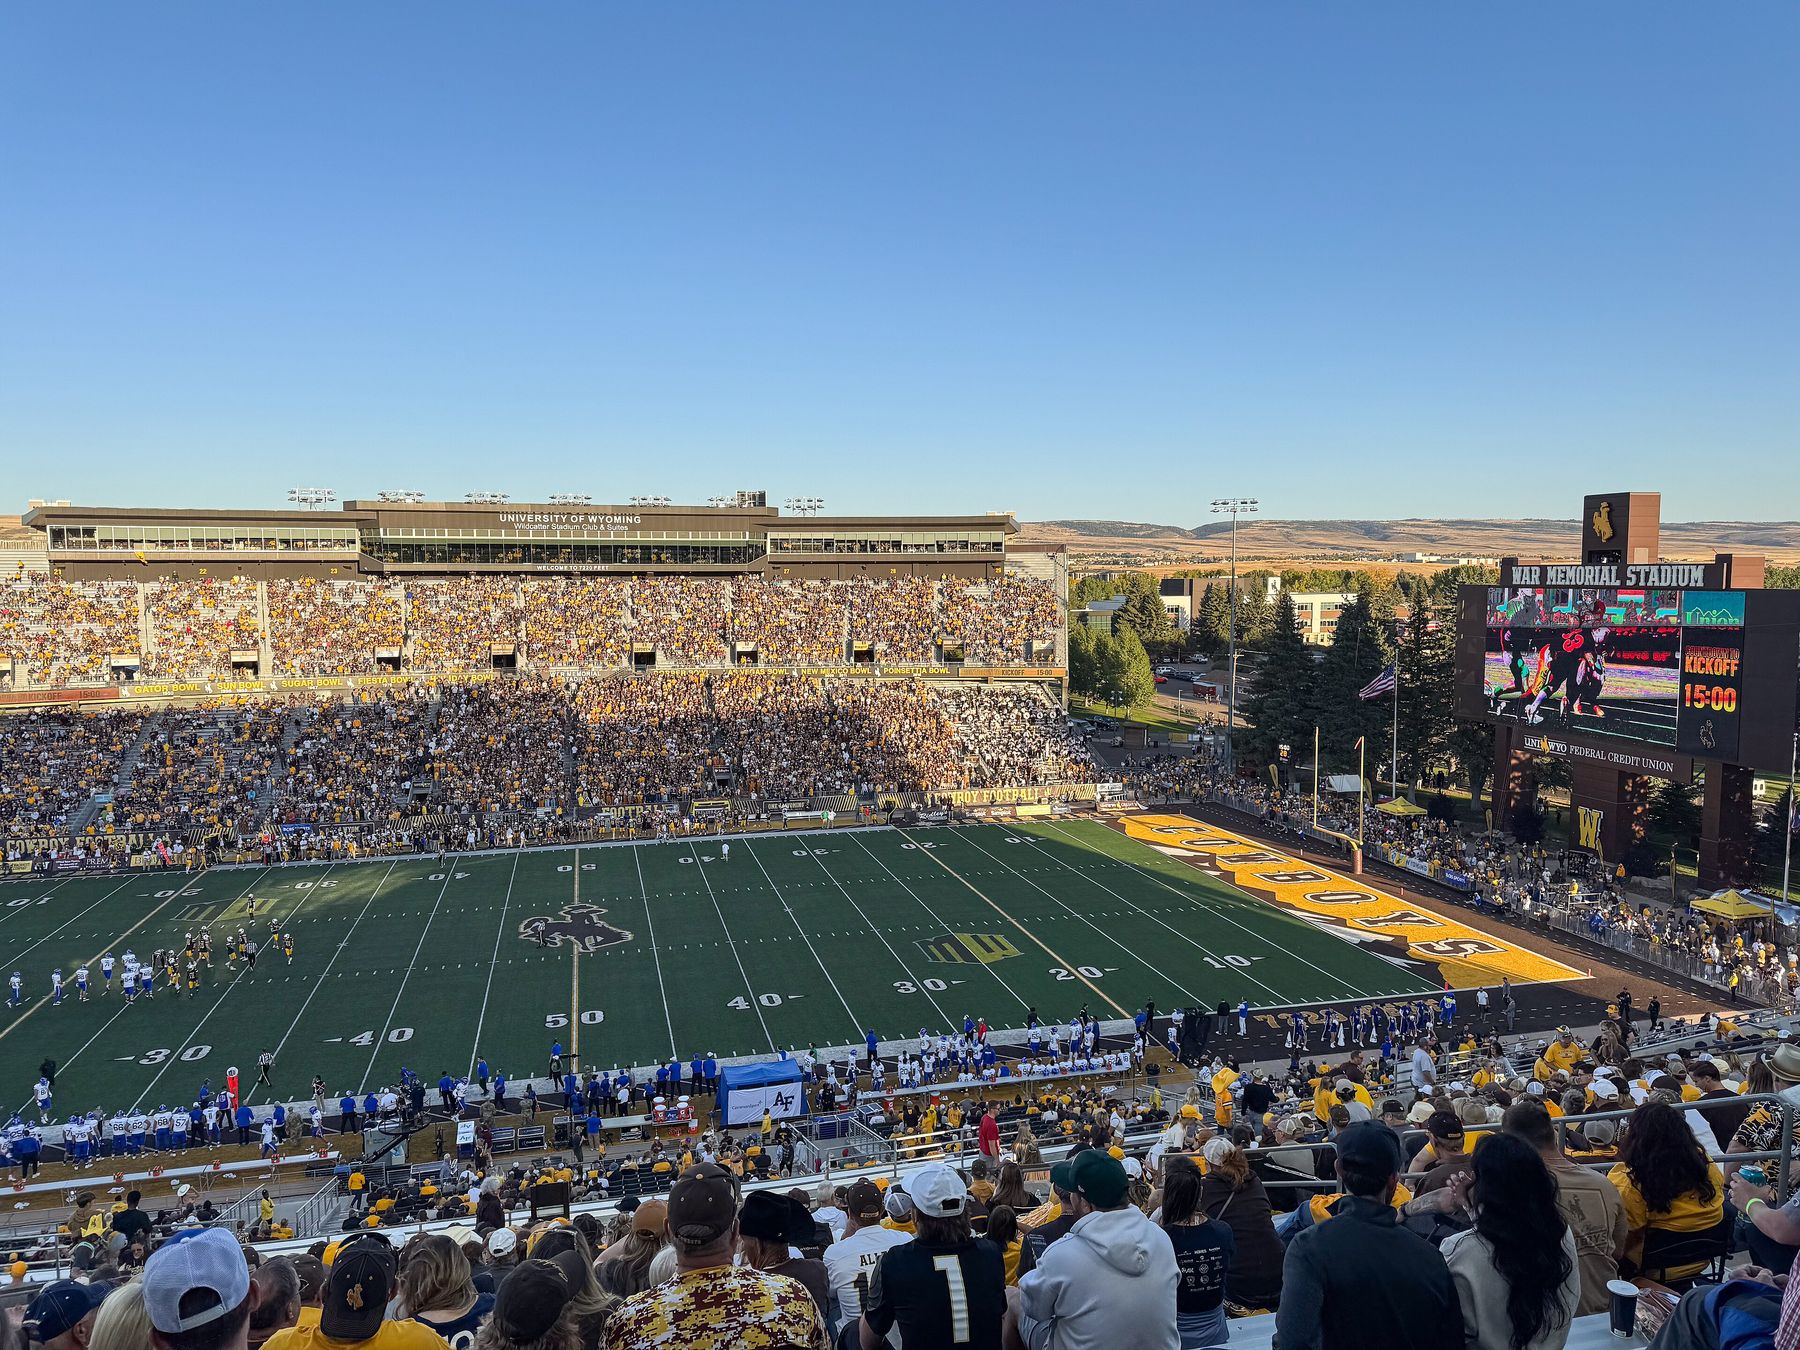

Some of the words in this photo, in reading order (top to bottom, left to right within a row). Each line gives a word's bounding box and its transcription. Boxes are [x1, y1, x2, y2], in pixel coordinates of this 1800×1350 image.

[500, 514, 567, 523] UNIVERSITY
[571, 515, 585, 523] OF
[588, 515, 641, 524] WYOMING
[514, 522, 549, 530] Wildcatter
[551, 523, 580, 531] Stadium
[582, 523, 598, 531] Club
[1512, 566, 1541, 585] WAR
[1546, 566, 1621, 586] MEMORIAL
[1626, 566, 1704, 587] STADIUM
[1684, 656, 1739, 677] KICKOFF
[134, 685, 169, 694] GATOR
[172, 683, 200, 692] BOWL
[217, 682, 238, 690] SUN
[238, 681, 266, 690] BOWL
[281, 679, 314, 688] SUGAR
[317, 678, 343, 687] BOWL
[358, 677, 388, 685] FIESTA
[28, 692, 62, 700] KICKOFF
[79, 690, 100, 698] 15:00
[1684, 683, 1737, 713] 15:00
[1570, 745, 1607, 760] FEDERAL
[1607, 751, 1640, 767] CREDIT
[1642, 758, 1674, 772] UNION
[982, 787, 1038, 802] FOOTBALL
[1577, 805, 1603, 849] W
[1151, 826, 1509, 957] COWBOYS
[1202, 954, 1251, 969] 10
[1048, 964, 1104, 981] 20
[893, 977, 948, 994] 30
[727, 992, 783, 1010] 40
[544, 1009, 605, 1028] 50
[348, 1026, 415, 1046] 40
[138, 1044, 213, 1066] 30
[773, 1091, 795, 1111] AF
[113, 1123, 124, 1131] 66
[132, 1121, 143, 1130] 62
[175, 1119, 187, 1127] 57
[933, 1254, 970, 1344] 1
